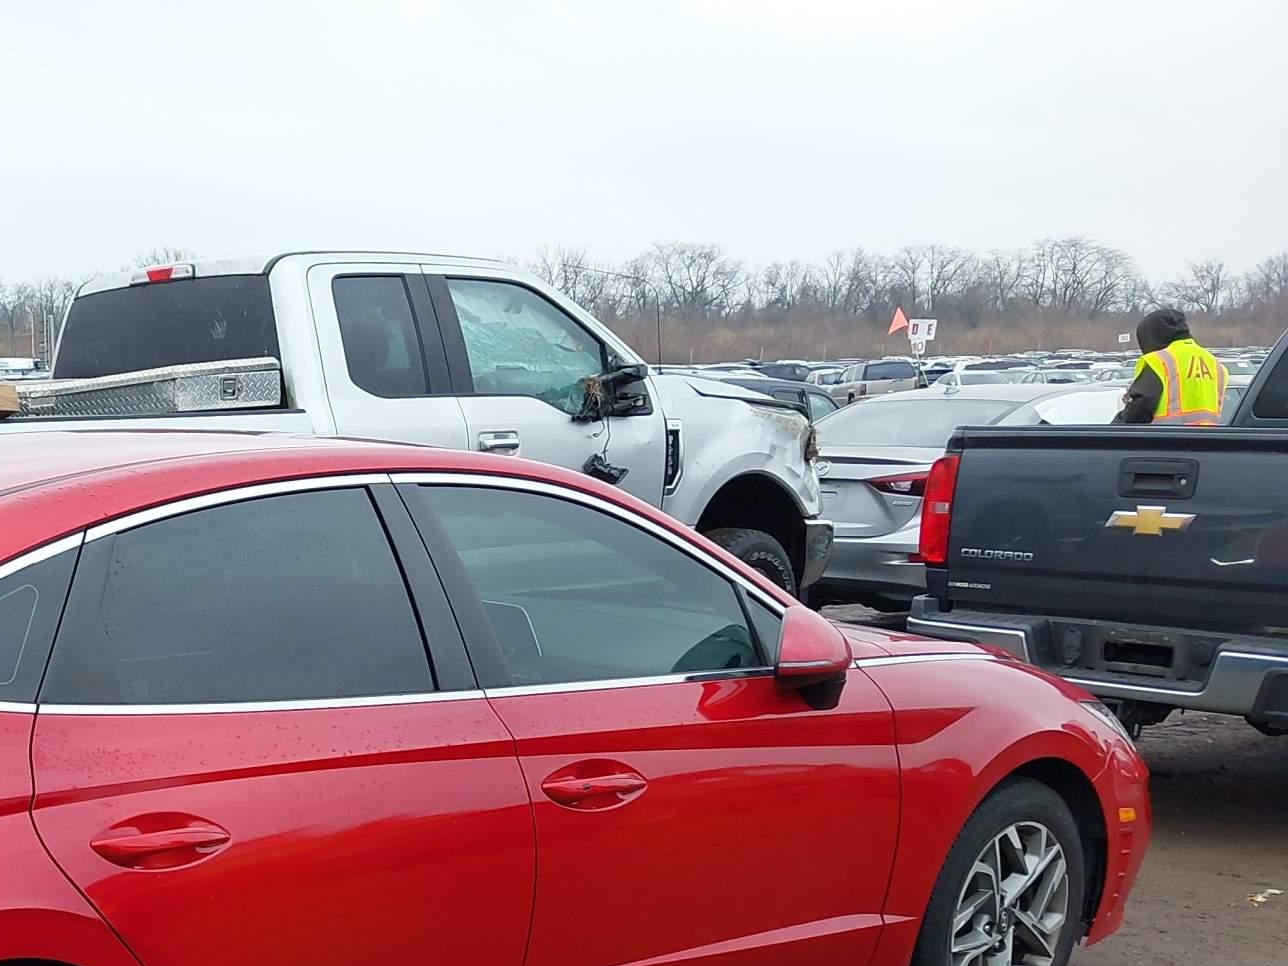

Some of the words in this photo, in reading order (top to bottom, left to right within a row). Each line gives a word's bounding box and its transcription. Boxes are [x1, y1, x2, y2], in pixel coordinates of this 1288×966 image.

[912, 323, 919, 335] D
[927, 323, 934, 336] E
[960, 548, 1034, 562] COLORADO
